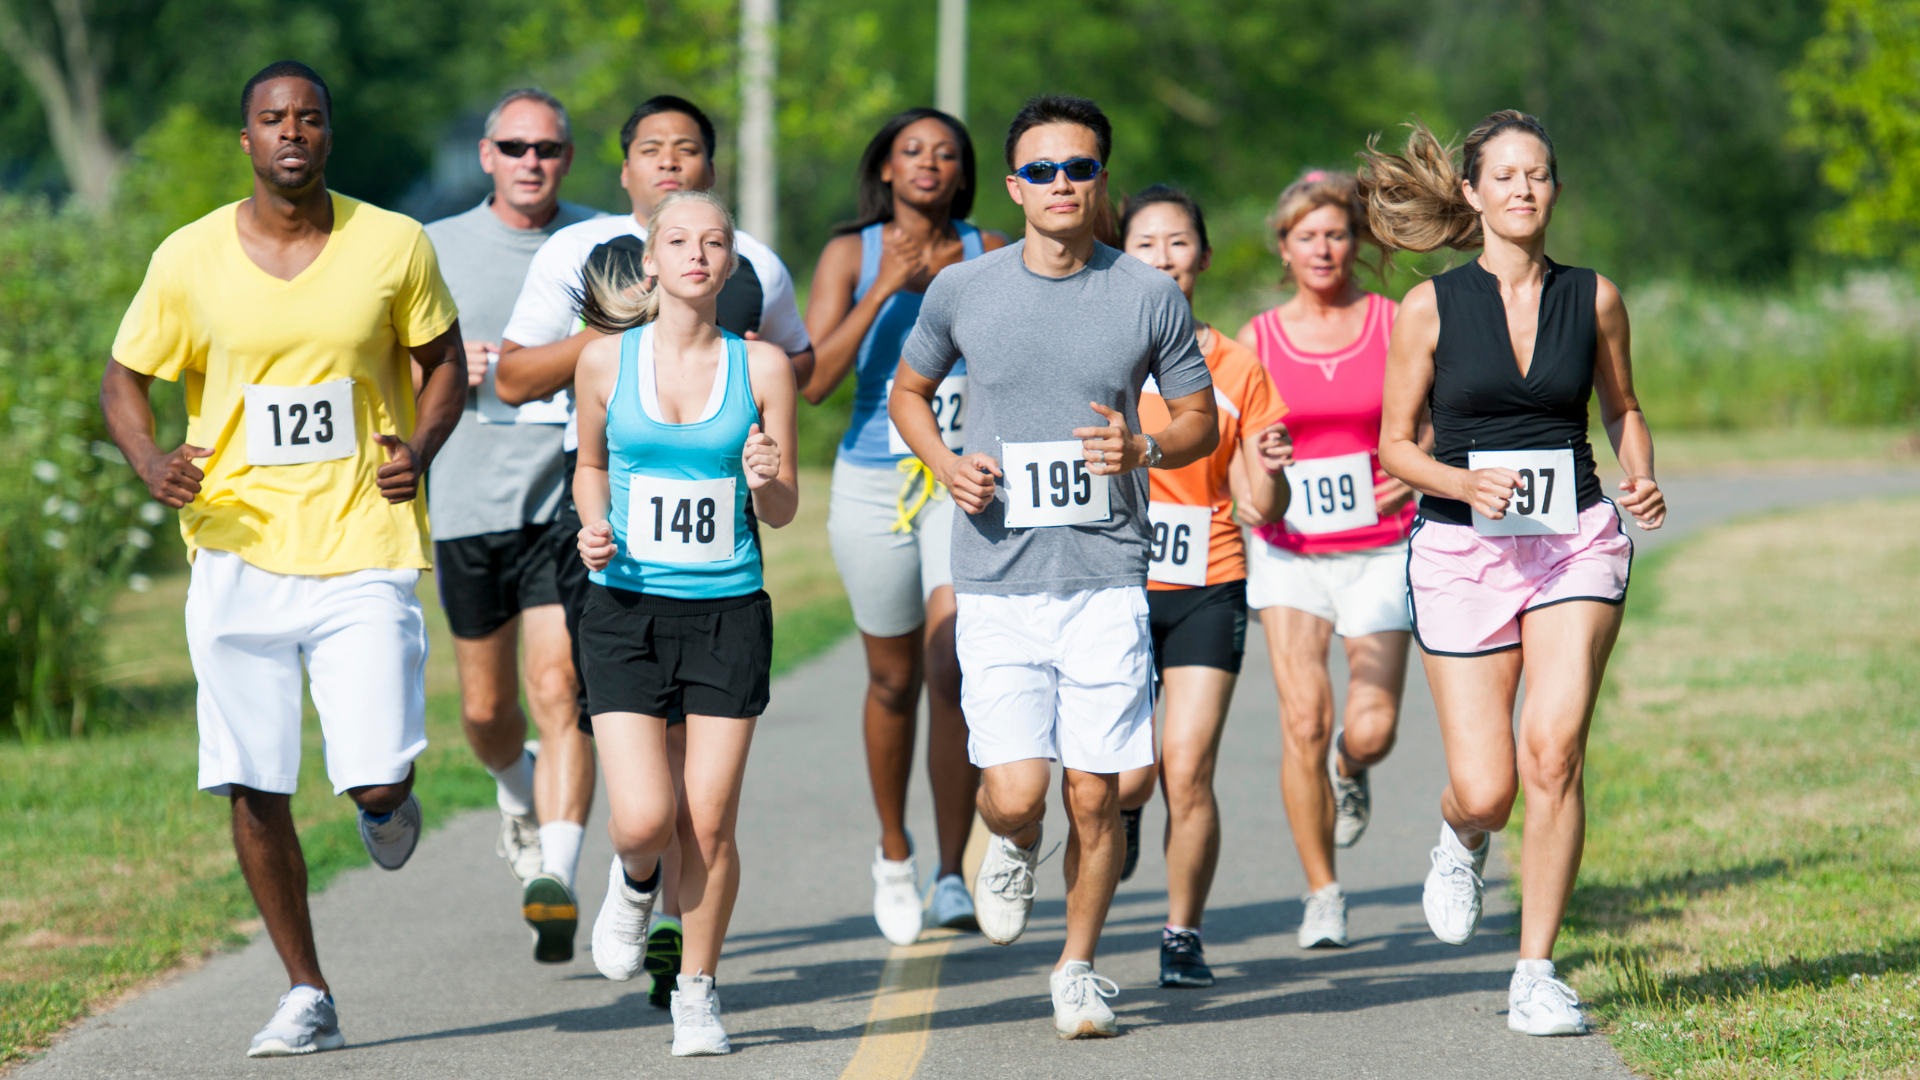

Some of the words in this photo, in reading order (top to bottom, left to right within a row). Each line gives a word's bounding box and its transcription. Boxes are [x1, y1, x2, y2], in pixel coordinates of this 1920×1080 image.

[268, 400, 334, 446] 123
[1025, 460, 1091, 507] 195
[1302, 474, 1355, 514] 199
[1503, 468, 1555, 516] 97
[651, 496, 715, 544] 148
[1151, 521, 1190, 565] 96
